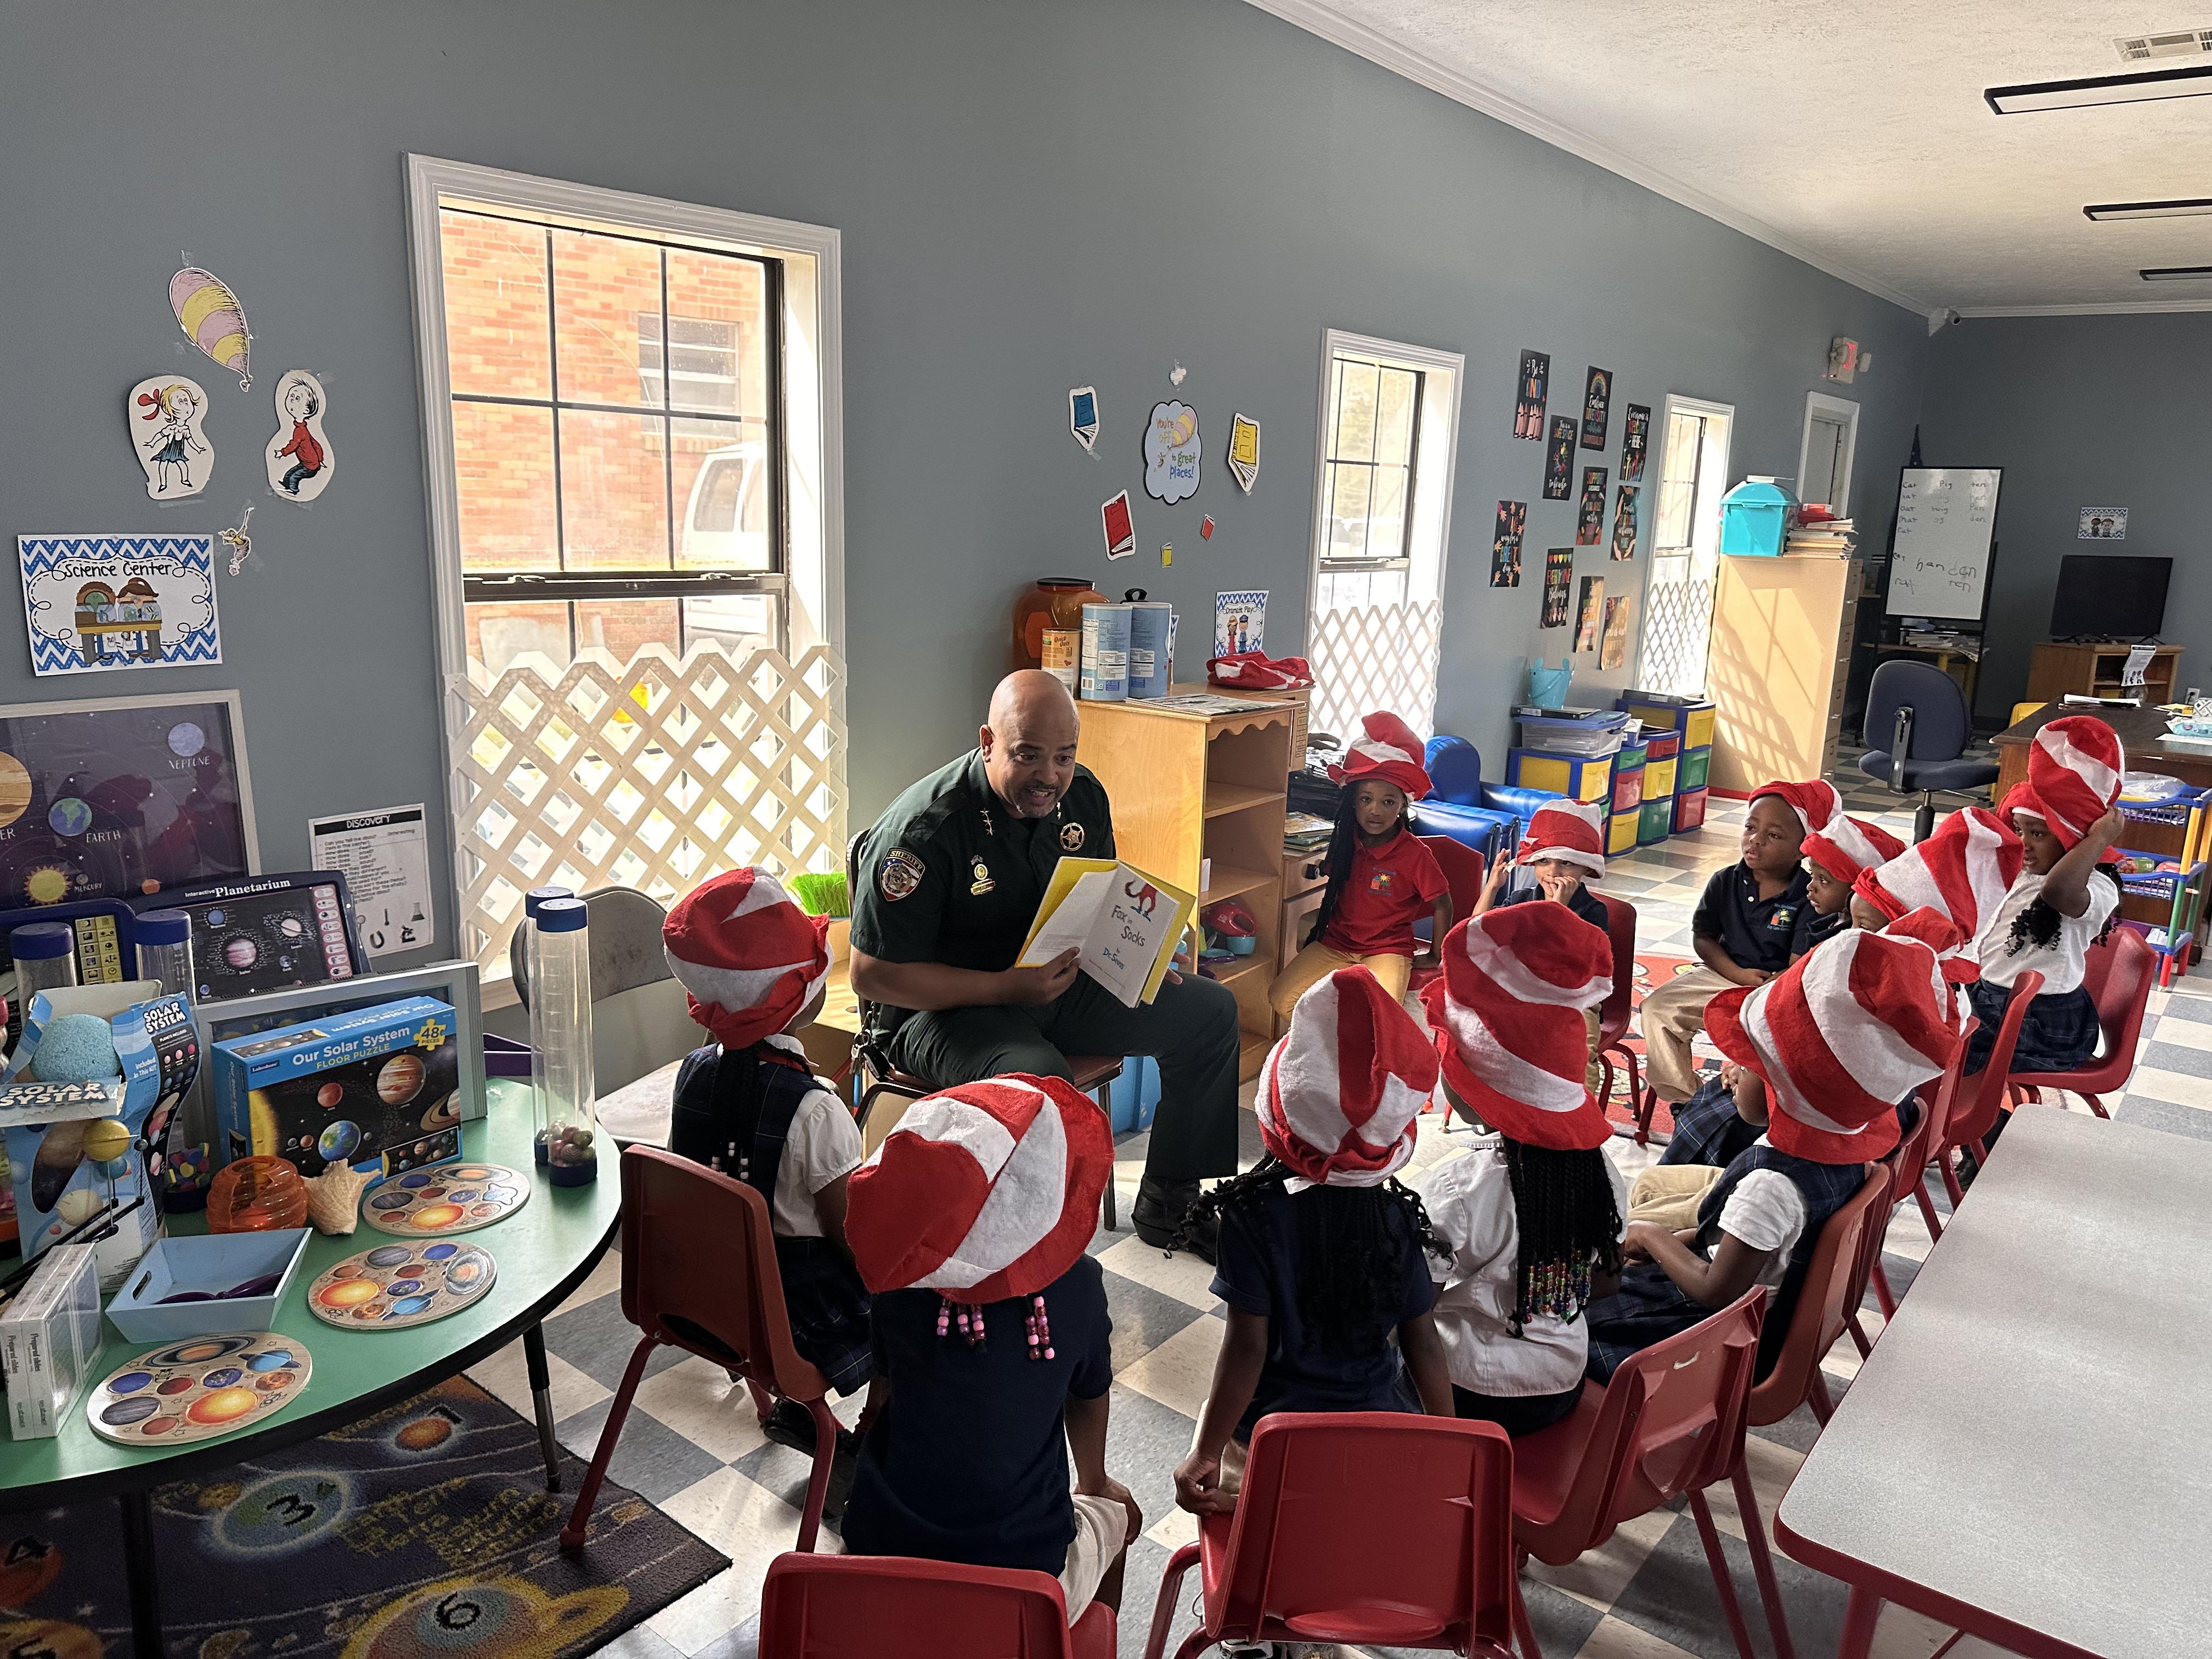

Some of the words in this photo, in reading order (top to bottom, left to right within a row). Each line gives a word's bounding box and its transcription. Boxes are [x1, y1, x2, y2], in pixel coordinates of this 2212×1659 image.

[1156, 417, 1174, 428] You're
[1159, 431, 1172, 443] off
[1172, 453, 1176, 461] to
[1177, 452, 1195, 467] great
[1170, 466, 1194, 479] places!
[1939, 480, 1953, 489] Pig
[65, 564, 117, 578] Science
[123, 562, 172, 577] Center
[1547, 585, 1567, 607] Belongs
[169, 755, 211, 769] NEPTUNE
[86, 830, 121, 843] EARTH
[890, 850, 923, 870] SHERIFF
[74, 882, 103, 893] MERCURY
[185, 889, 216, 898] Interactive
[215, 879, 291, 898] Planetarium
[1111, 905, 1127, 924] Fox
[1121, 926, 1146, 946] Socks
[1111, 953, 1125, 969] Seuss
[144, 1002, 179, 1023] SOLAR
[145, 1011, 186, 1033] SYSTEM
[421, 1026, 440, 1039] 48
[292, 1052, 319, 1066] Our
[323, 1040, 359, 1058] Solar
[362, 1026, 411, 1047] System
[316, 1054, 351, 1070] FLOOR
[353, 1042, 391, 1059] PUZZLE
[8, 1081, 101, 1096] SOLAR
[0, 1091, 106, 1108] SYSTEM
[7, 1335, 18, 1359] Prepared
[29, 1333, 41, 1357] Prepared
[10, 1359, 19, 1374] slides
[33, 1357, 41, 1372] slides
[266, 1493, 317, 1528] 3
[436, 1591, 481, 1630] 6
